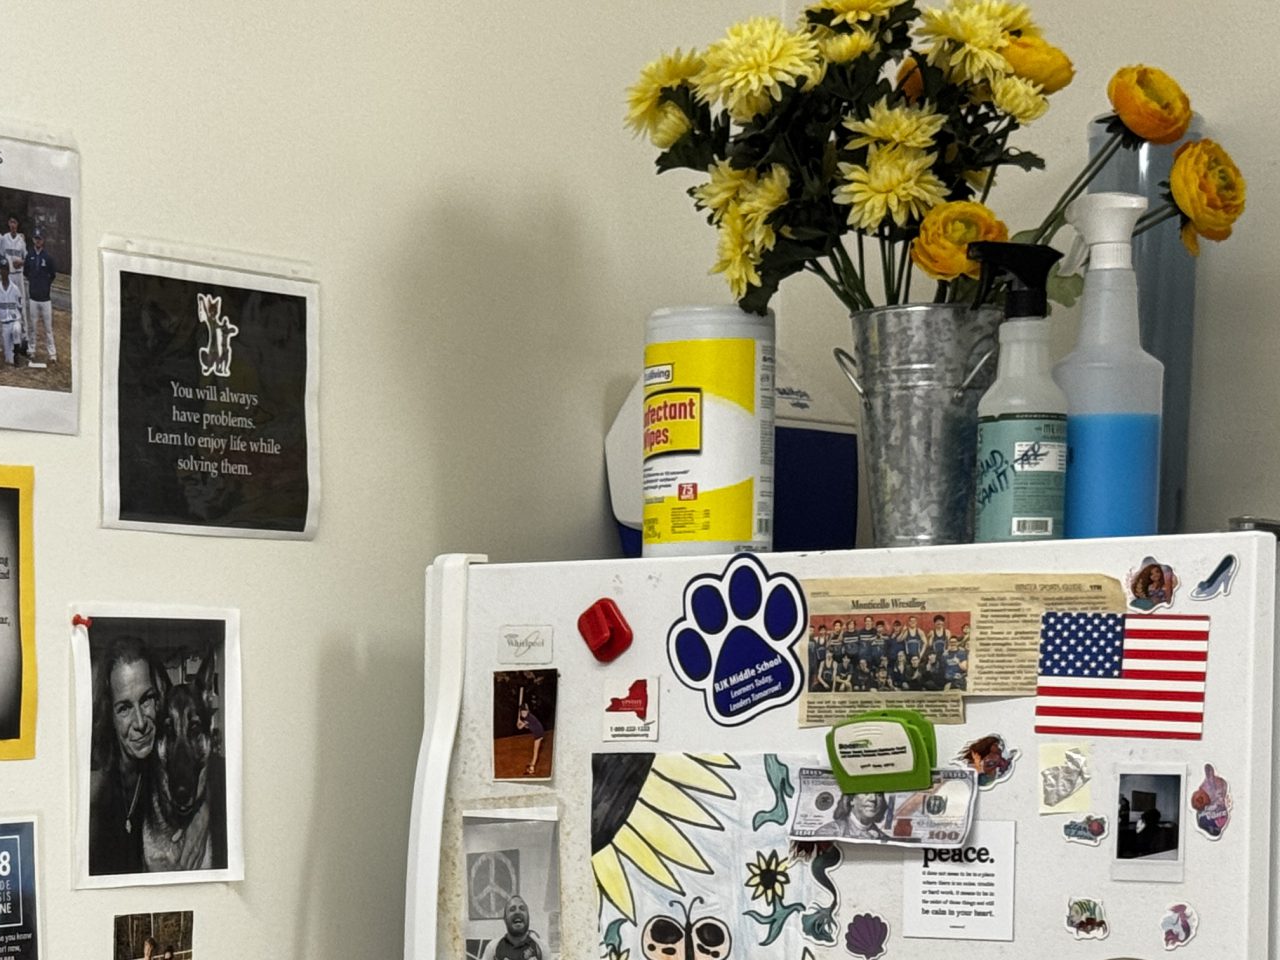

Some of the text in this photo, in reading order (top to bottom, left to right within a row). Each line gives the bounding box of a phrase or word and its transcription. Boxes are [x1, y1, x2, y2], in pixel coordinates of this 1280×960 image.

[170, 381, 258, 410] You will always
[172, 405, 256, 429] have problems.
[644, 398, 696, 429] fectant
[147, 427, 281, 455] Learn to enjoy life while
[644, 427, 669, 452] ipes
[177, 455, 252, 478] solving them.
[682, 485, 693, 495] 75
[714, 654, 782, 693] RJK Middle School
[928, 831, 960, 841] 100
[922, 847, 995, 868] peace.
[956, 910, 972, 918] your
[5, 934, 16, 944] you
